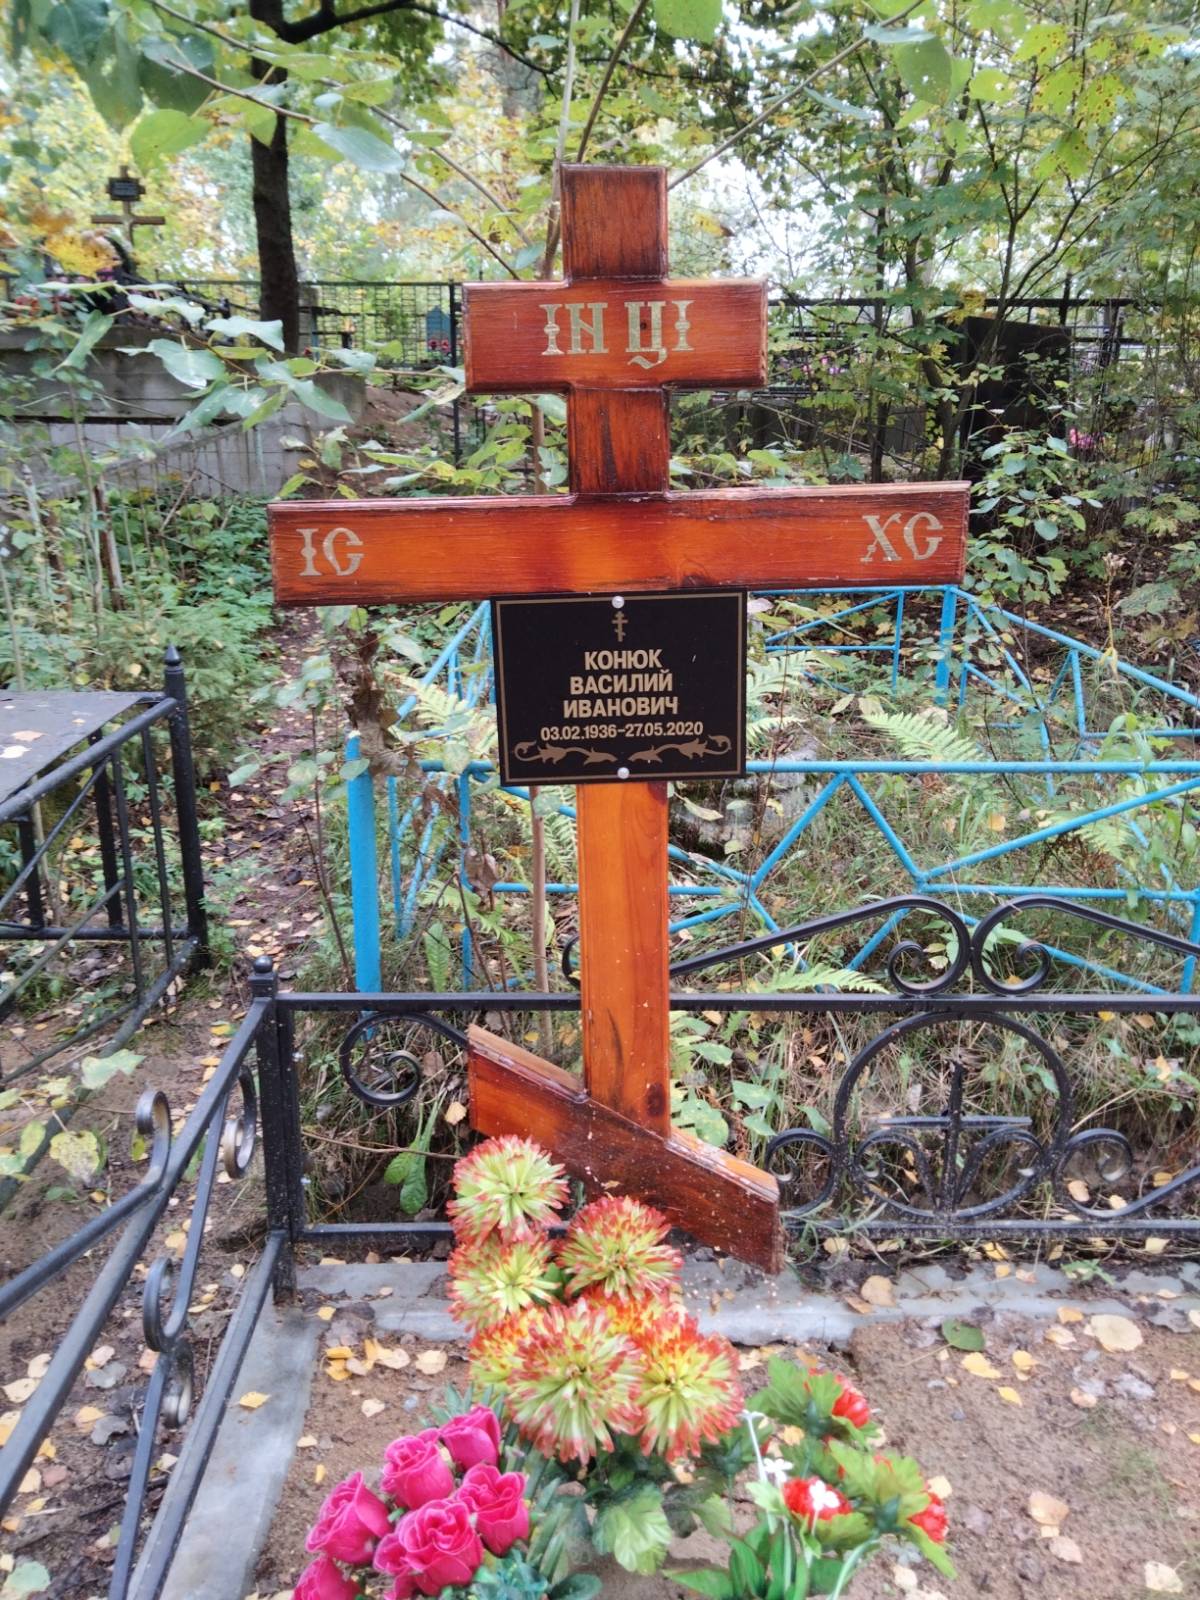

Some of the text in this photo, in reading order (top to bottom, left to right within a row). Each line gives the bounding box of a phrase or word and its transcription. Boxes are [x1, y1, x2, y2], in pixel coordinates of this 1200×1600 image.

[584, 649, 662, 670] КОНЮК
[570, 669, 673, 695] ВАСИЛИЙ
[563, 696, 679, 718] ИВАНОВИЧ
